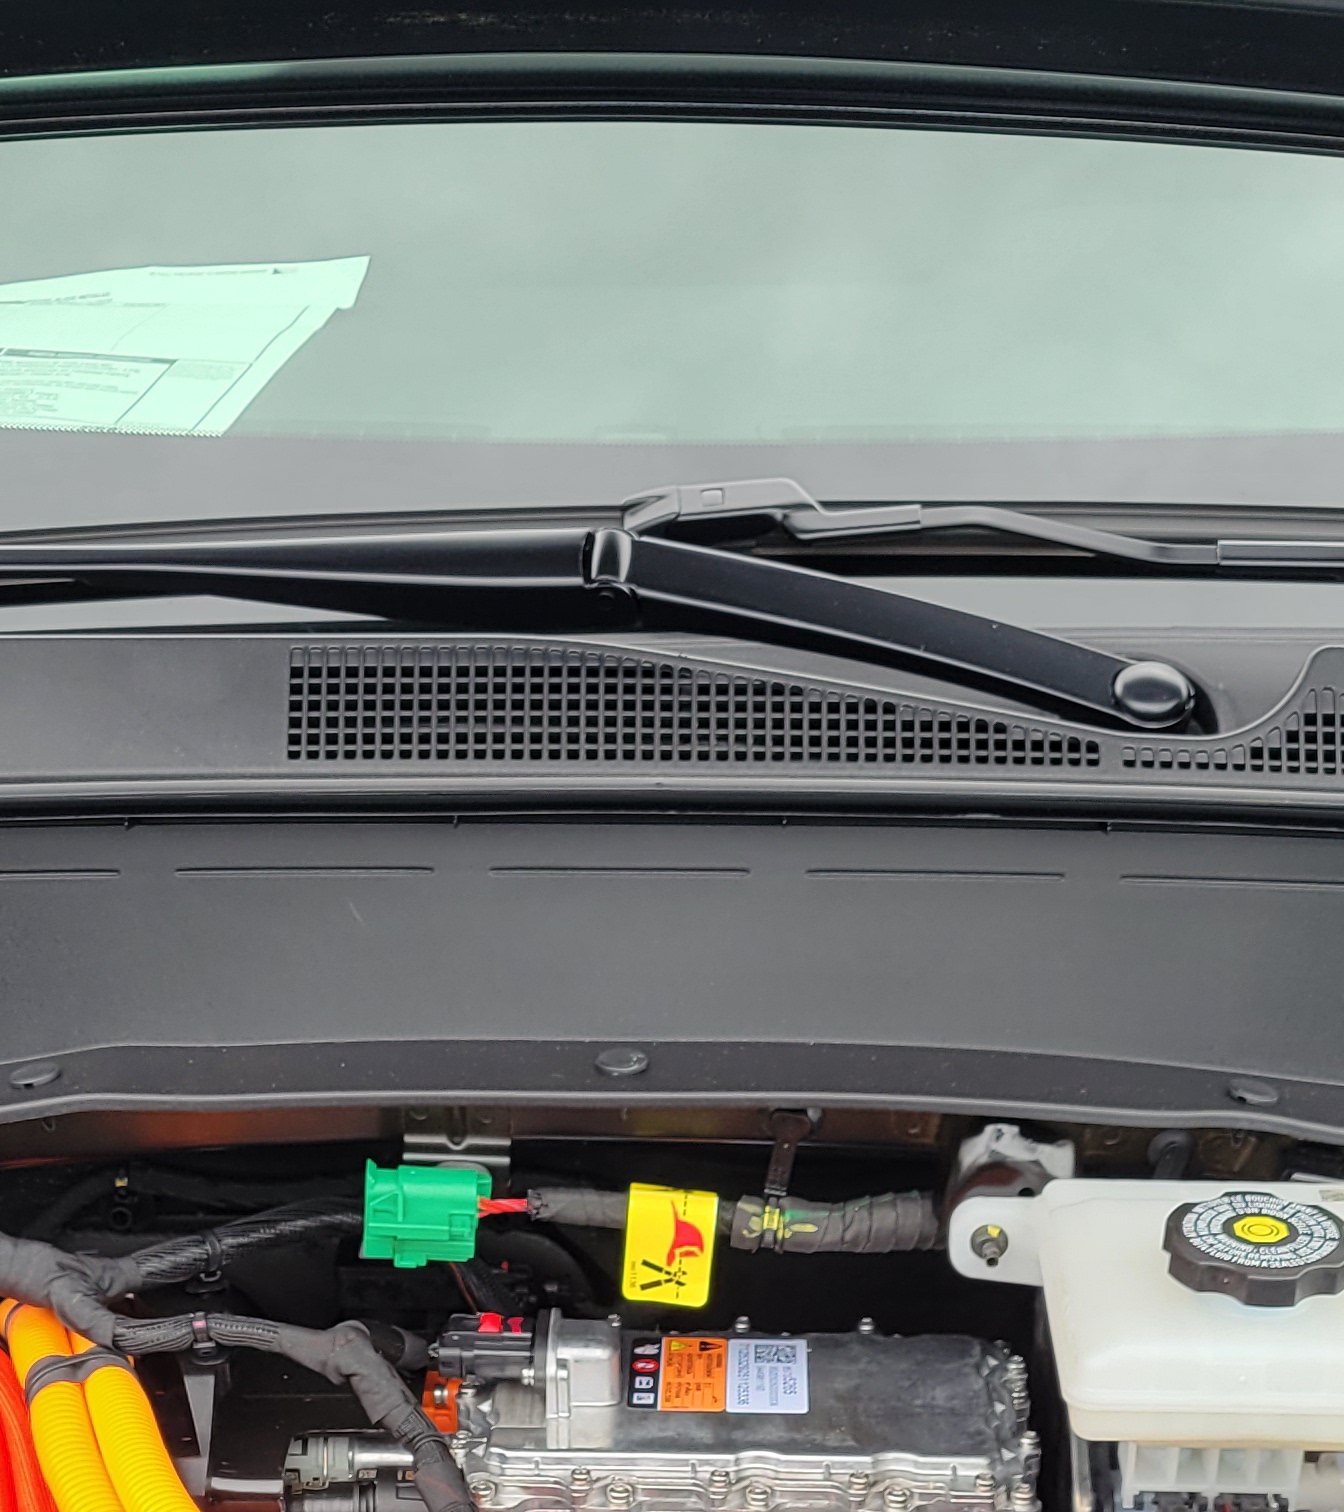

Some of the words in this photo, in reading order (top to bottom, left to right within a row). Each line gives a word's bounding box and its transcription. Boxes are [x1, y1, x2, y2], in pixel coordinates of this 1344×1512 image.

[1244, 1194, 1289, 1207] BOUCHON
[1261, 1208, 1287, 1220] BIDON
[1231, 1256, 1261, 1268] FROM
